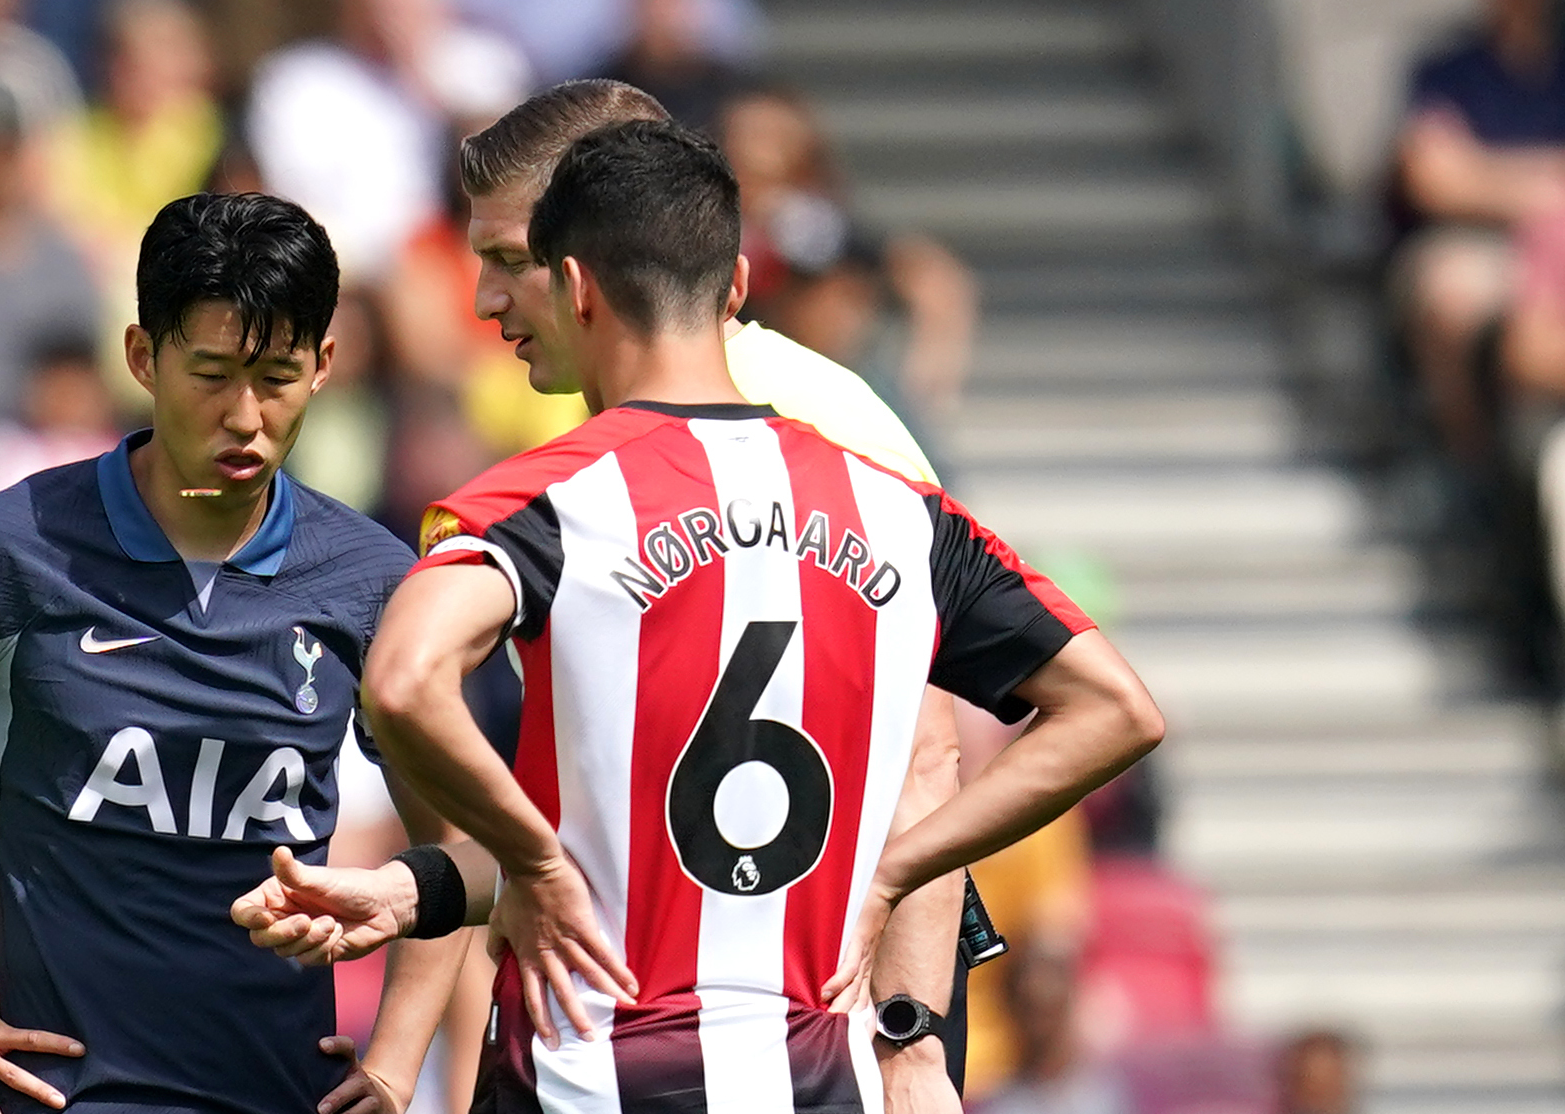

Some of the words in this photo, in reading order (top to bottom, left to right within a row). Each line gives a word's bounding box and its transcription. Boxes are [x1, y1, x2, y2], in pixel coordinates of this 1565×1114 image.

[610, 498, 902, 612] NØRGAARD
[67, 726, 317, 841] AIA
[666, 620, 834, 896] 6
